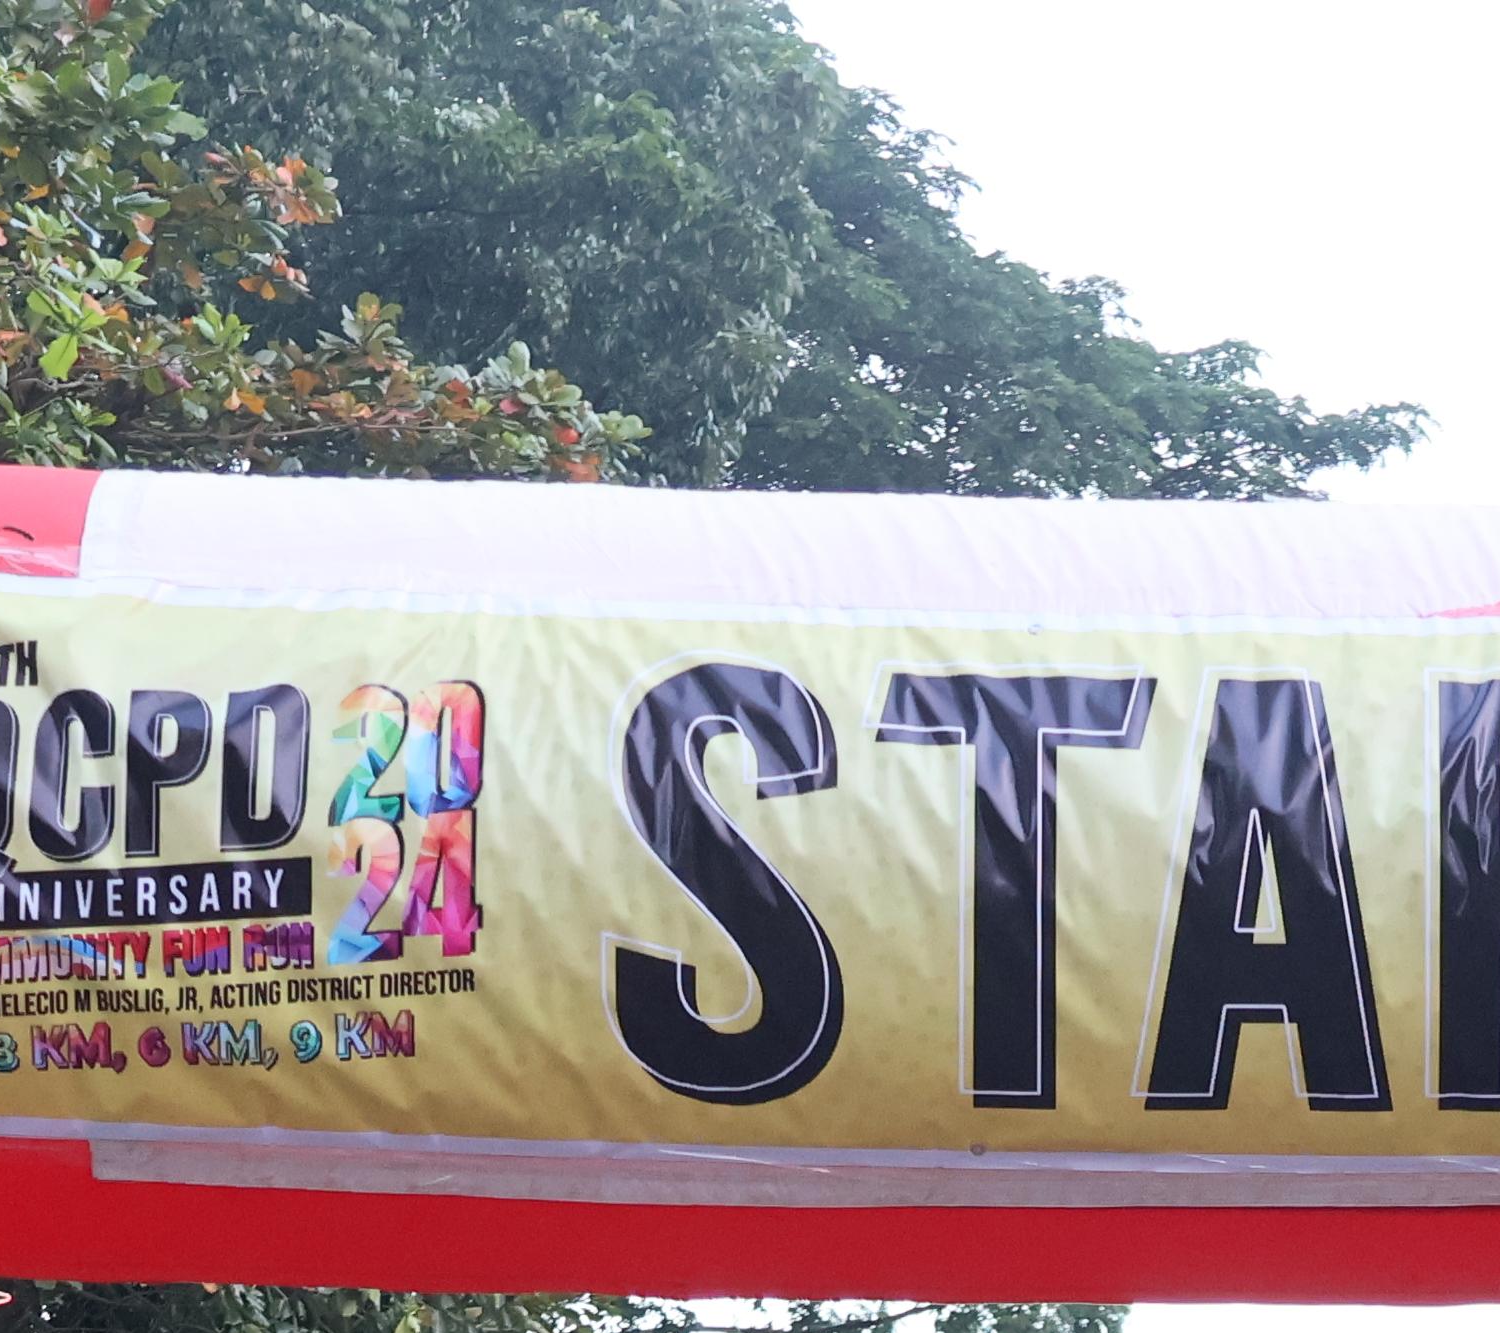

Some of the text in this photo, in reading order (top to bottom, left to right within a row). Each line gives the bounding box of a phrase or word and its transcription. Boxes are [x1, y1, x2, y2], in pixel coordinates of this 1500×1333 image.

[328, 680, 486, 826] 20
[327, 806, 485, 967] 24
[164, 926, 233, 978] FUN
[243, 922, 315, 972] RUN
[75, 991, 92, 1014] M
[97, 986, 169, 1015] BUSLIG,
[210, 980, 281, 1008] ACTING
[287, 973, 375, 1005] DISTRICT
[379, 968, 476, 999] DIRECTOR
[31, 1021, 127, 1073] KM,
[138, 1026, 171, 1066] 6
[183, 1018, 277, 1069] KM,
[293, 1020, 322, 1061] 9
[335, 1009, 415, 1059] KM
